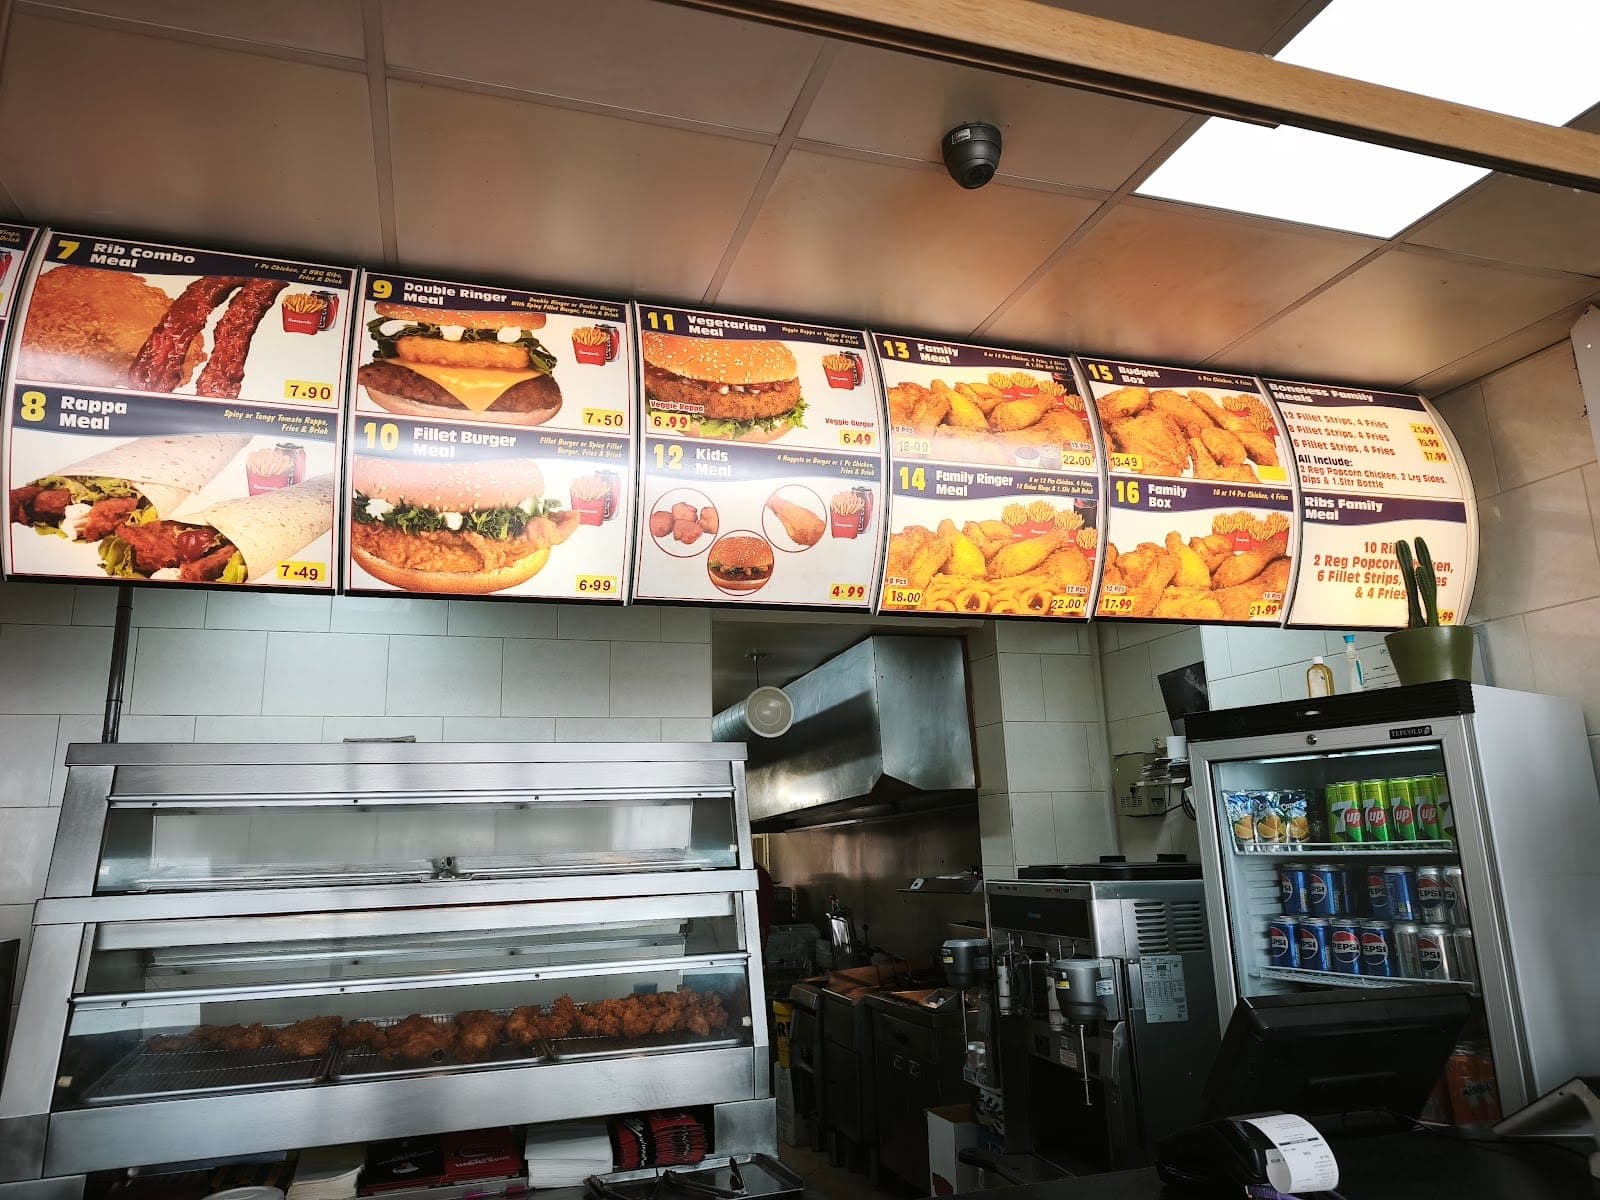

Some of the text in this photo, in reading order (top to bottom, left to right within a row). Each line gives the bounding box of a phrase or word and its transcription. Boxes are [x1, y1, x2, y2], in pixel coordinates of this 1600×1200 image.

[57, 240, 80, 260] 7
[93, 243, 196, 264] Rib Combo
[90, 254, 138, 268] Meal
[372, 280, 393, 299] 9
[404, 282, 507, 303] Double Ringer
[403, 292, 444, 306] Meal
[648, 312, 674, 331] 11
[687, 315, 767, 333] Vegetarian
[688, 324, 724, 337] Meal
[884, 340, 910, 359] 13
[917, 344, 959, 357] Family
[920, 352, 951, 364] Meal
[1088, 363, 1114, 382] 15
[1118, 366, 1161, 379] Budget
[1122, 375, 1145, 385] Box
[290, 385, 331, 400] 7.90
[1273, 392, 1313, 403] Meals
[1331, 390, 1374, 402] Family
[20, 390, 47, 422] 8
[61, 396, 128, 415] Rappa
[59, 412, 110, 430] Meal
[224, 410, 243, 420] Spicy
[255, 412, 276, 423] Tangy
[278, 414, 303, 424] Tomato
[586, 412, 624, 427] 7.50
[654, 416, 688, 428] 6.99
[825, 418, 874, 428] Veggie Burger
[1296, 412, 1322, 422] Fillet
[1326, 415, 1356, 426] Strips,
[1364, 420, 1389, 429] Fries
[282, 424, 300, 433] Fries
[309, 427, 329, 435] Drink
[1297, 426, 1322, 436] Fillet
[1366, 432, 1390, 442] Fries
[364, 422, 399, 452] 10
[414, 427, 517, 448] Fillet Burger
[540, 436, 556, 445] Fillet
[558, 438, 580, 448] Burger
[588, 441, 605, 450] Spicy
[606, 442, 623, 450] Fillet
[844, 433, 871, 445] 6.49
[413, 443, 455, 458] Meal
[582, 449, 597, 457] Fries
[696, 448, 729, 462] Kids
[1294, 440, 1300, 448] 6
[1302, 440, 1327, 450] Fillet
[1330, 442, 1362, 454] Strips,
[1372, 446, 1395, 456] Fries
[654, 444, 684, 470] 12
[782, 455, 805, 464] Nuggets
[813, 457, 831, 467] Burger
[1063, 454, 1091, 466] 22.00
[1112, 456, 1138, 467] 13.49
[1298, 454, 1353, 467] All Include:
[696, 463, 732, 477] Meal
[840, 467, 853, 475] Fries
[1308, 466, 1325, 477] Reg
[1327, 466, 1362, 478] Popcorn
[1364, 470, 1400, 481] Chicken,
[1401, 472, 1406, 480] 2
[900, 466, 926, 491] 14
[936, 470, 1014, 487] Family Ringer
[1302, 476, 1322, 486] Dips
[1324, 476, 1329, 484] &
[1357, 478, 1384, 489] Bottle
[936, 484, 968, 497] Meal
[1116, 480, 1140, 504] 16
[1148, 484, 1188, 499] Family
[1276, 493, 1289, 501] Fries
[1148, 496, 1172, 509] Box
[1304, 497, 1383, 513] Ribs Family
[1305, 510, 1339, 521] Meal
[1364, 542, 1377, 554] 10
[1314, 555, 1320, 566] 2
[1325, 556, 1348, 570] Reg
[281, 564, 318, 581] 7.49
[1318, 570, 1402, 586] 6 Fillet Strips,
[580, 580, 611, 591] 6.99
[832, 586, 865, 597] 4.99
[1355, 587, 1407, 600] & 4 Fries
[1104, 599, 1132, 610] 17.99
[1250, 606, 1277, 615] 21.99
